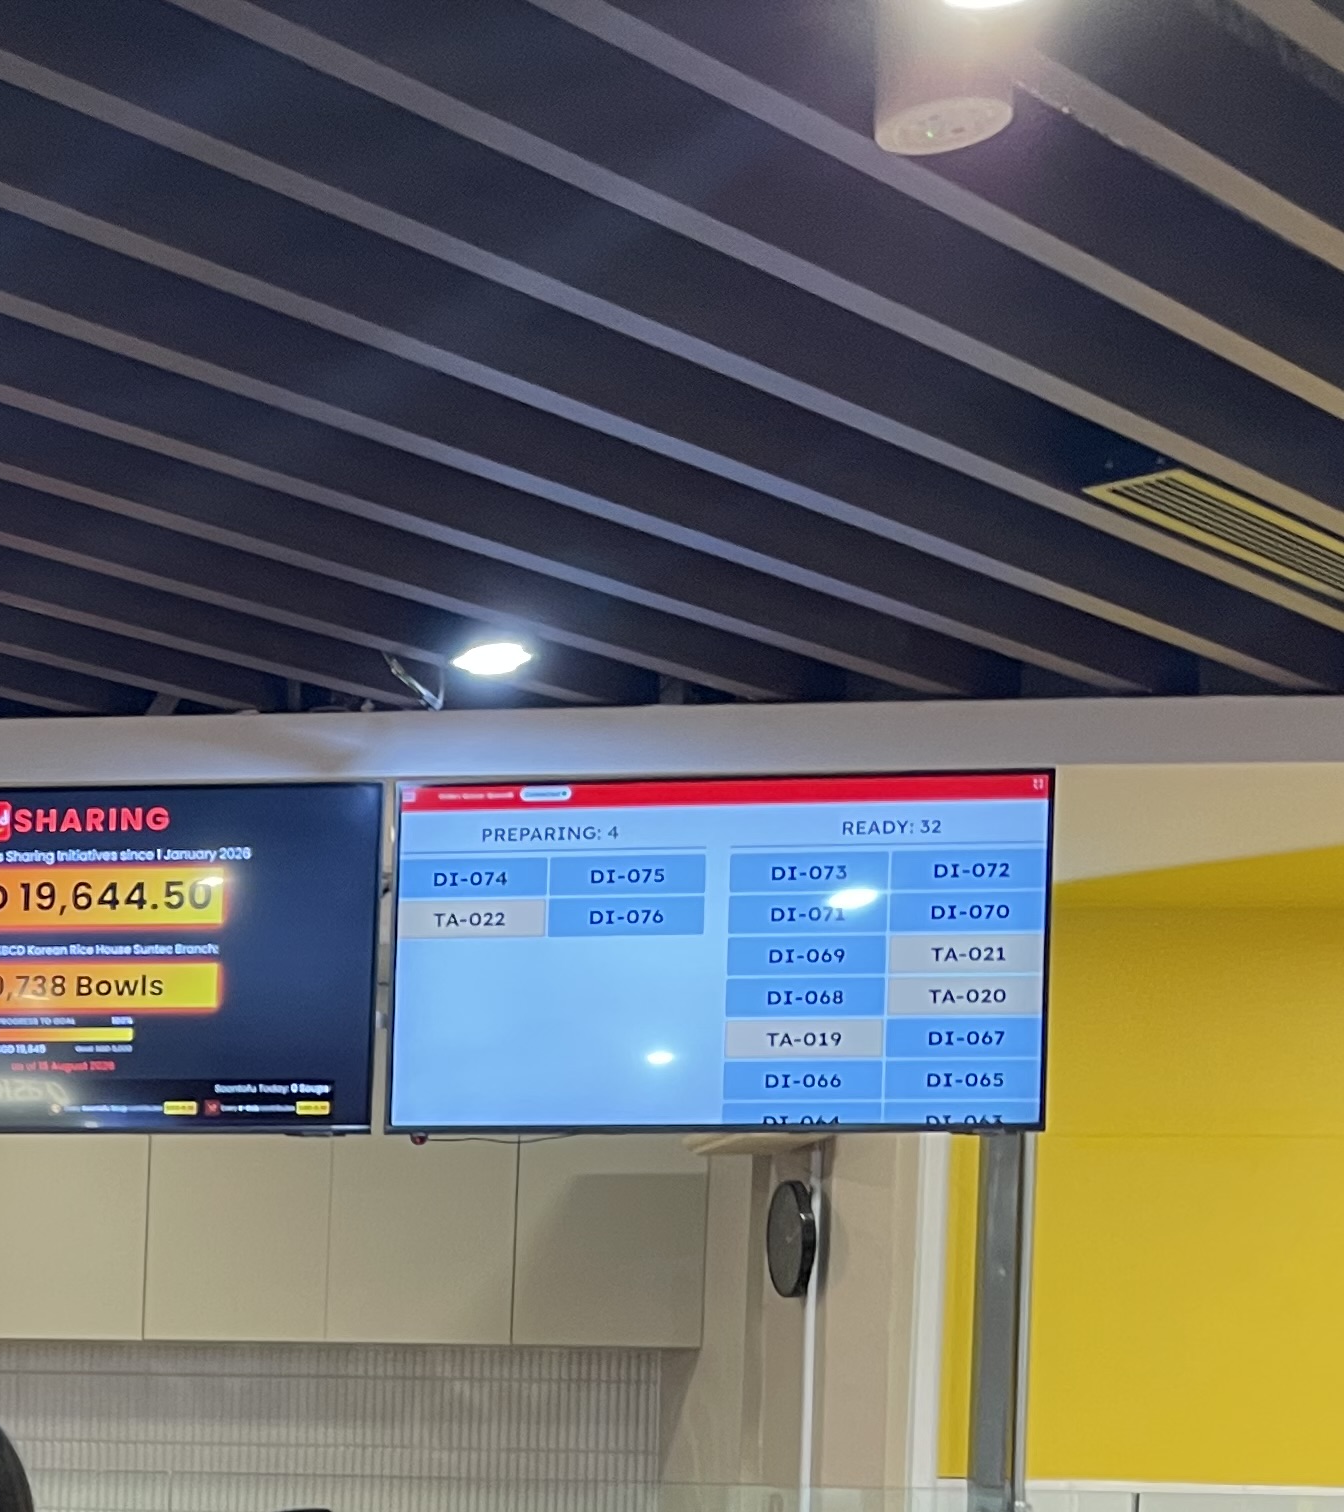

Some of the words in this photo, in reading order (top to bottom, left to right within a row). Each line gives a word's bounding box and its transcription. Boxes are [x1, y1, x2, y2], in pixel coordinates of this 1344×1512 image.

[14, 806, 171, 833] SHARING
[481, 826, 602, 842] PREPARING:
[607, 825, 619, 840] 4
[842, 821, 914, 836] READY:
[919, 820, 942, 834] 32
[6, 849, 56, 865] Sharing
[57, 848, 118, 862] Initiatives
[120, 848, 154, 861] since
[163, 848, 218, 863] January
[590, 868, 666, 884] DI-075
[771, 865, 848, 881] DI-073
[933, 862, 1011, 879] DI-072
[433, 871, 508, 887] DI-074
[20, 880, 212, 917] 19,644.50
[433, 911, 506, 928] TA-022
[589, 909, 664, 925] DI-076
[770, 906, 846, 923] DI-071
[930, 904, 1010, 920] DI-070
[27, 944, 68, 956] Korean
[69, 944, 93, 956] Rice
[95, 943, 131, 956] House
[133, 943, 173, 956] Suntec
[768, 948, 846, 965] DI-069
[930, 947, 1007, 962] TA-021
[76, 974, 164, 996] Bowls
[767, 990, 844, 1006] DI-068
[928, 989, 1007, 1004] TA-020
[766, 1032, 842, 1047] TA-019
[927, 1030, 1005, 1046] DI-067
[764, 1073, 842, 1089] DI-066
[926, 1072, 1004, 1088] DI-065
